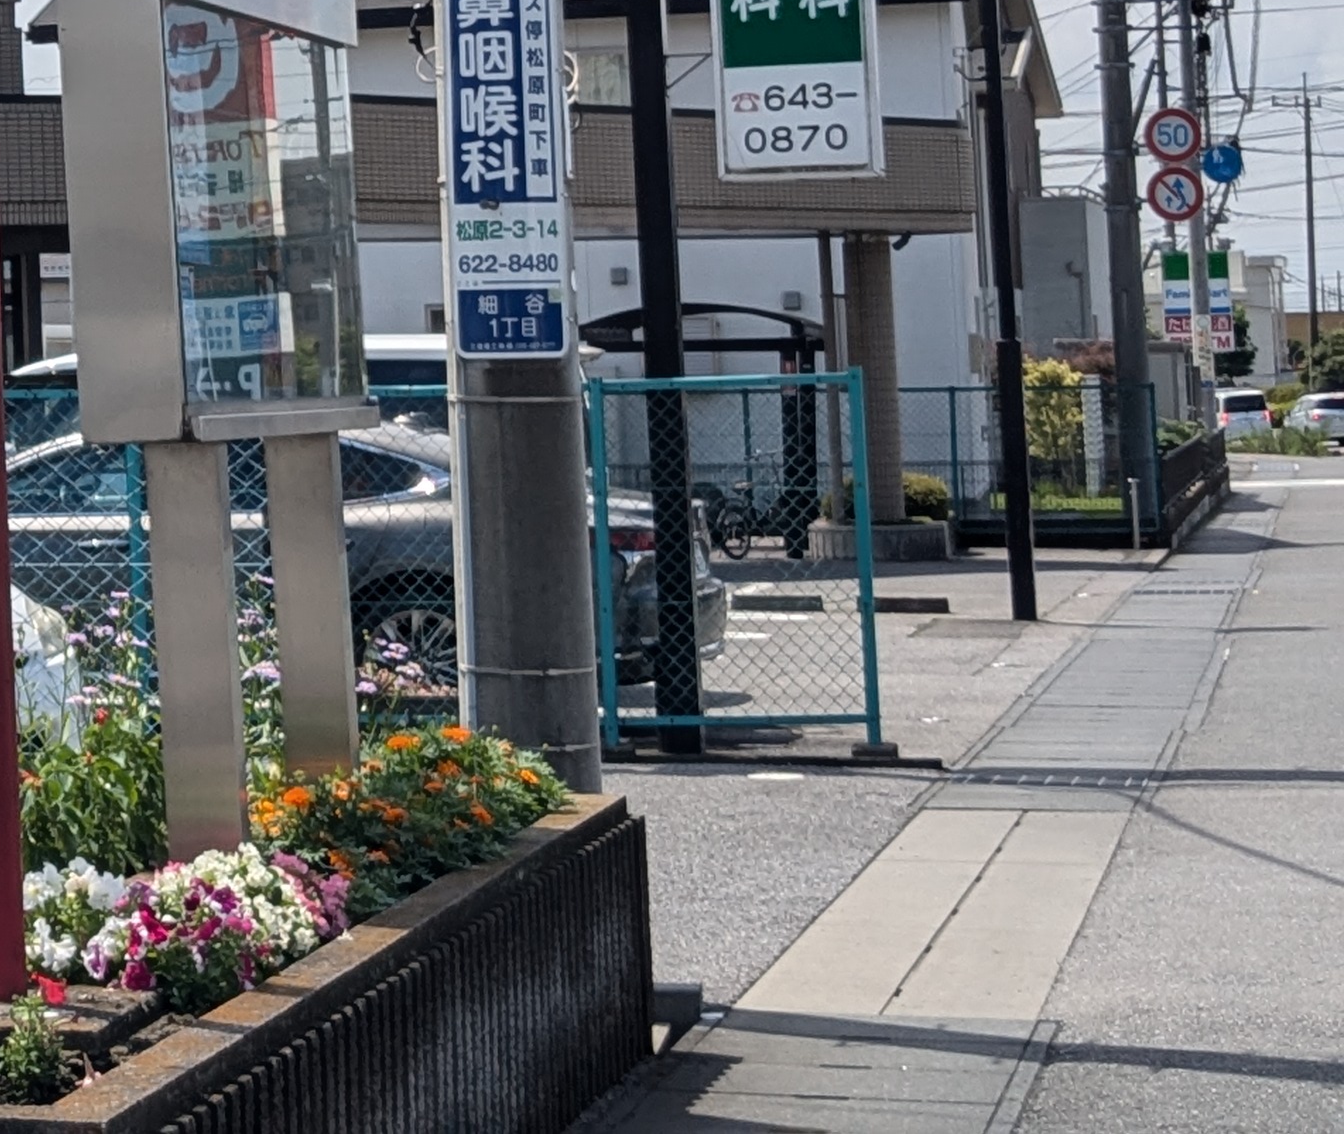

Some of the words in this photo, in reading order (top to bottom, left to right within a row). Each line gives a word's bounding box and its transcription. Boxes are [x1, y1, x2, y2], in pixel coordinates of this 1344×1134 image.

[744, 123, 848, 155] 0870
[1157, 123, 1189, 148] 50
[456, 220, 558, 241] 松原2-3-14
[458, 254, 558, 274] 622-8480
[477, 293, 545, 315] 細谷
[488, 316, 537, 338] 1丁目
